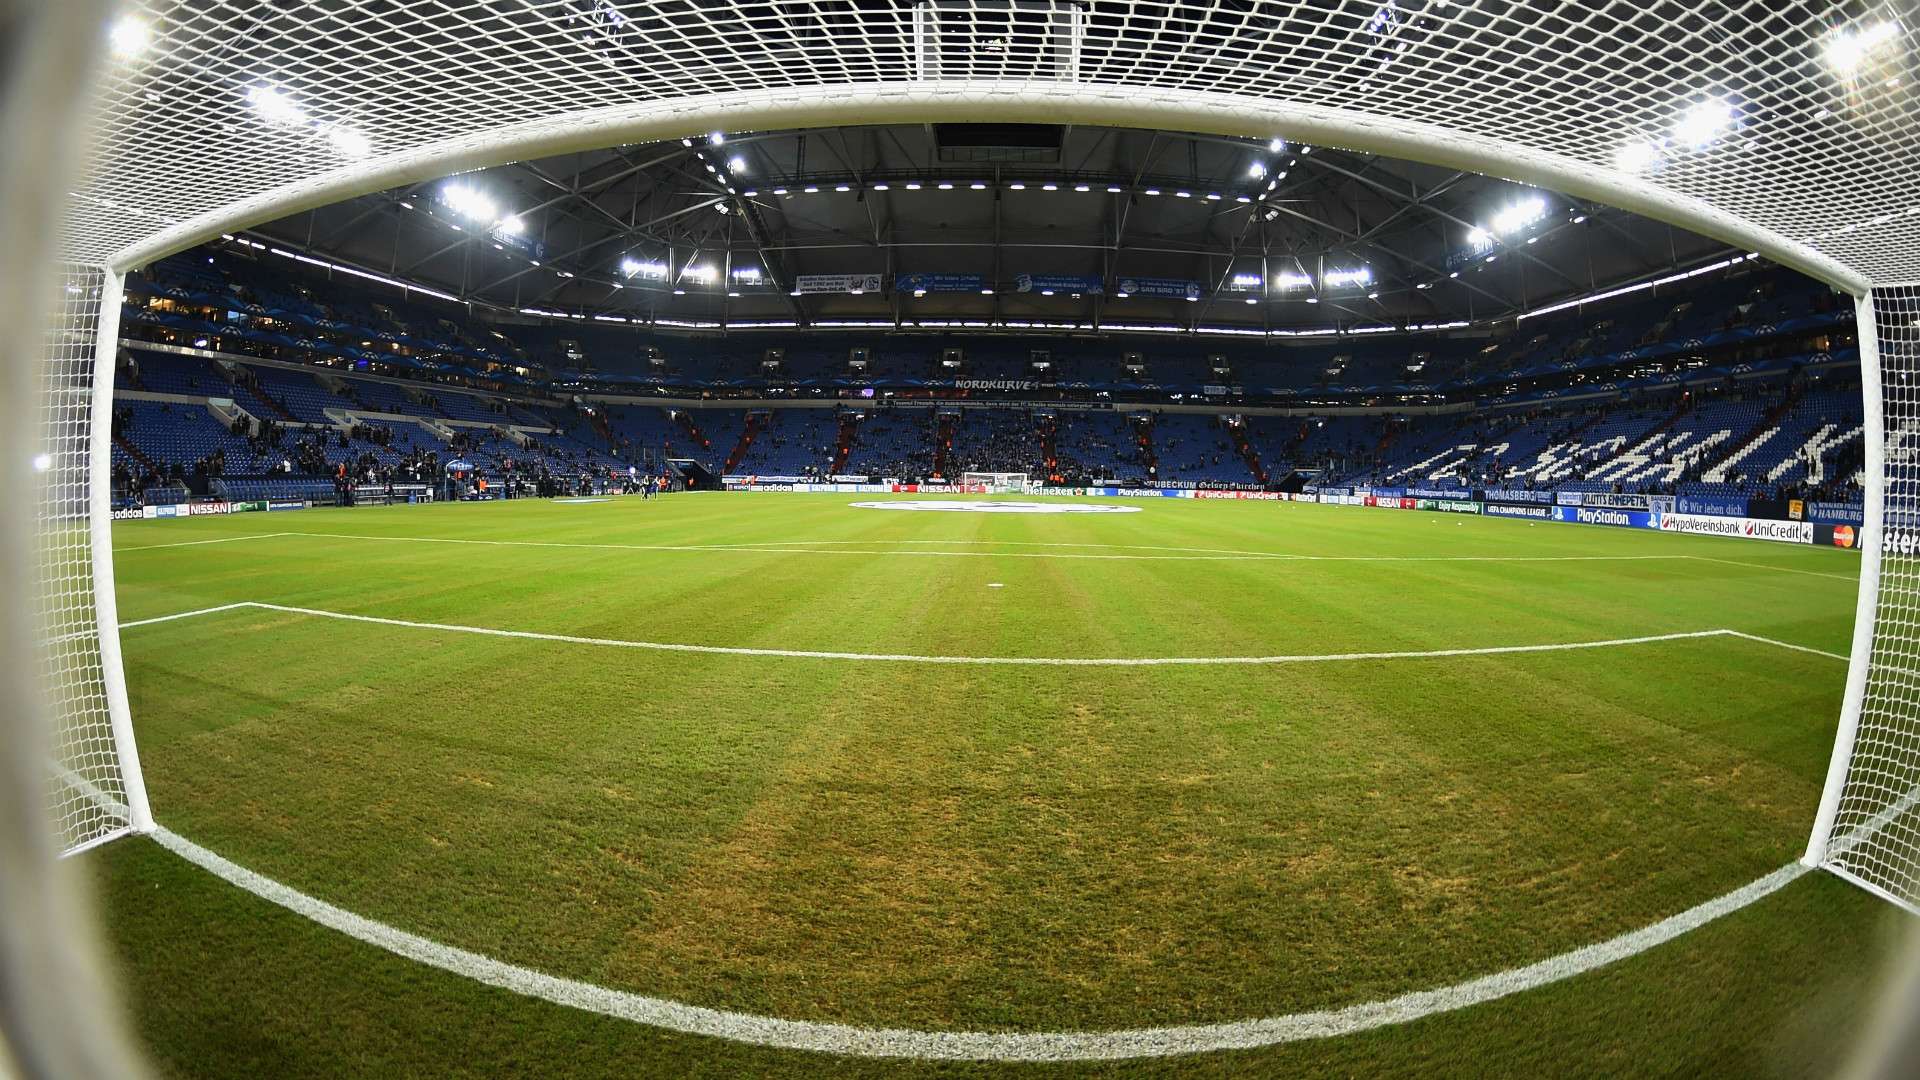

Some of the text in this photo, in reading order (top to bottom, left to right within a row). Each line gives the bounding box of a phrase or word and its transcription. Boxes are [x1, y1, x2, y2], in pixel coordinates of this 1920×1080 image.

[763, 484, 792, 492] adidas
[917, 485, 960, 493] NISSAN
[1024, 486, 1073, 496] Heineken
[1118, 489, 1163, 497] PlayStation
[1206, 491, 1236, 499] UniCredit
[1247, 491, 1278, 500] UniCredit
[1485, 491, 1535, 501] THOMASBERG
[1376, 497, 1400, 508] NISSAN
[114, 508, 142, 519] adidas
[190, 503, 227, 515] NISSAN
[1487, 505, 1545, 517] UEFA CHAMPIONS LEAGUE
[1690, 503, 1744, 515] Wir leben dich.
[1577, 507, 1628, 525] PlayStation
[1818, 509, 1862, 521] HAMBURG
[1670, 516, 1740, 535] HypoVereinsbank
[1754, 521, 1799, 539] UniCredit
